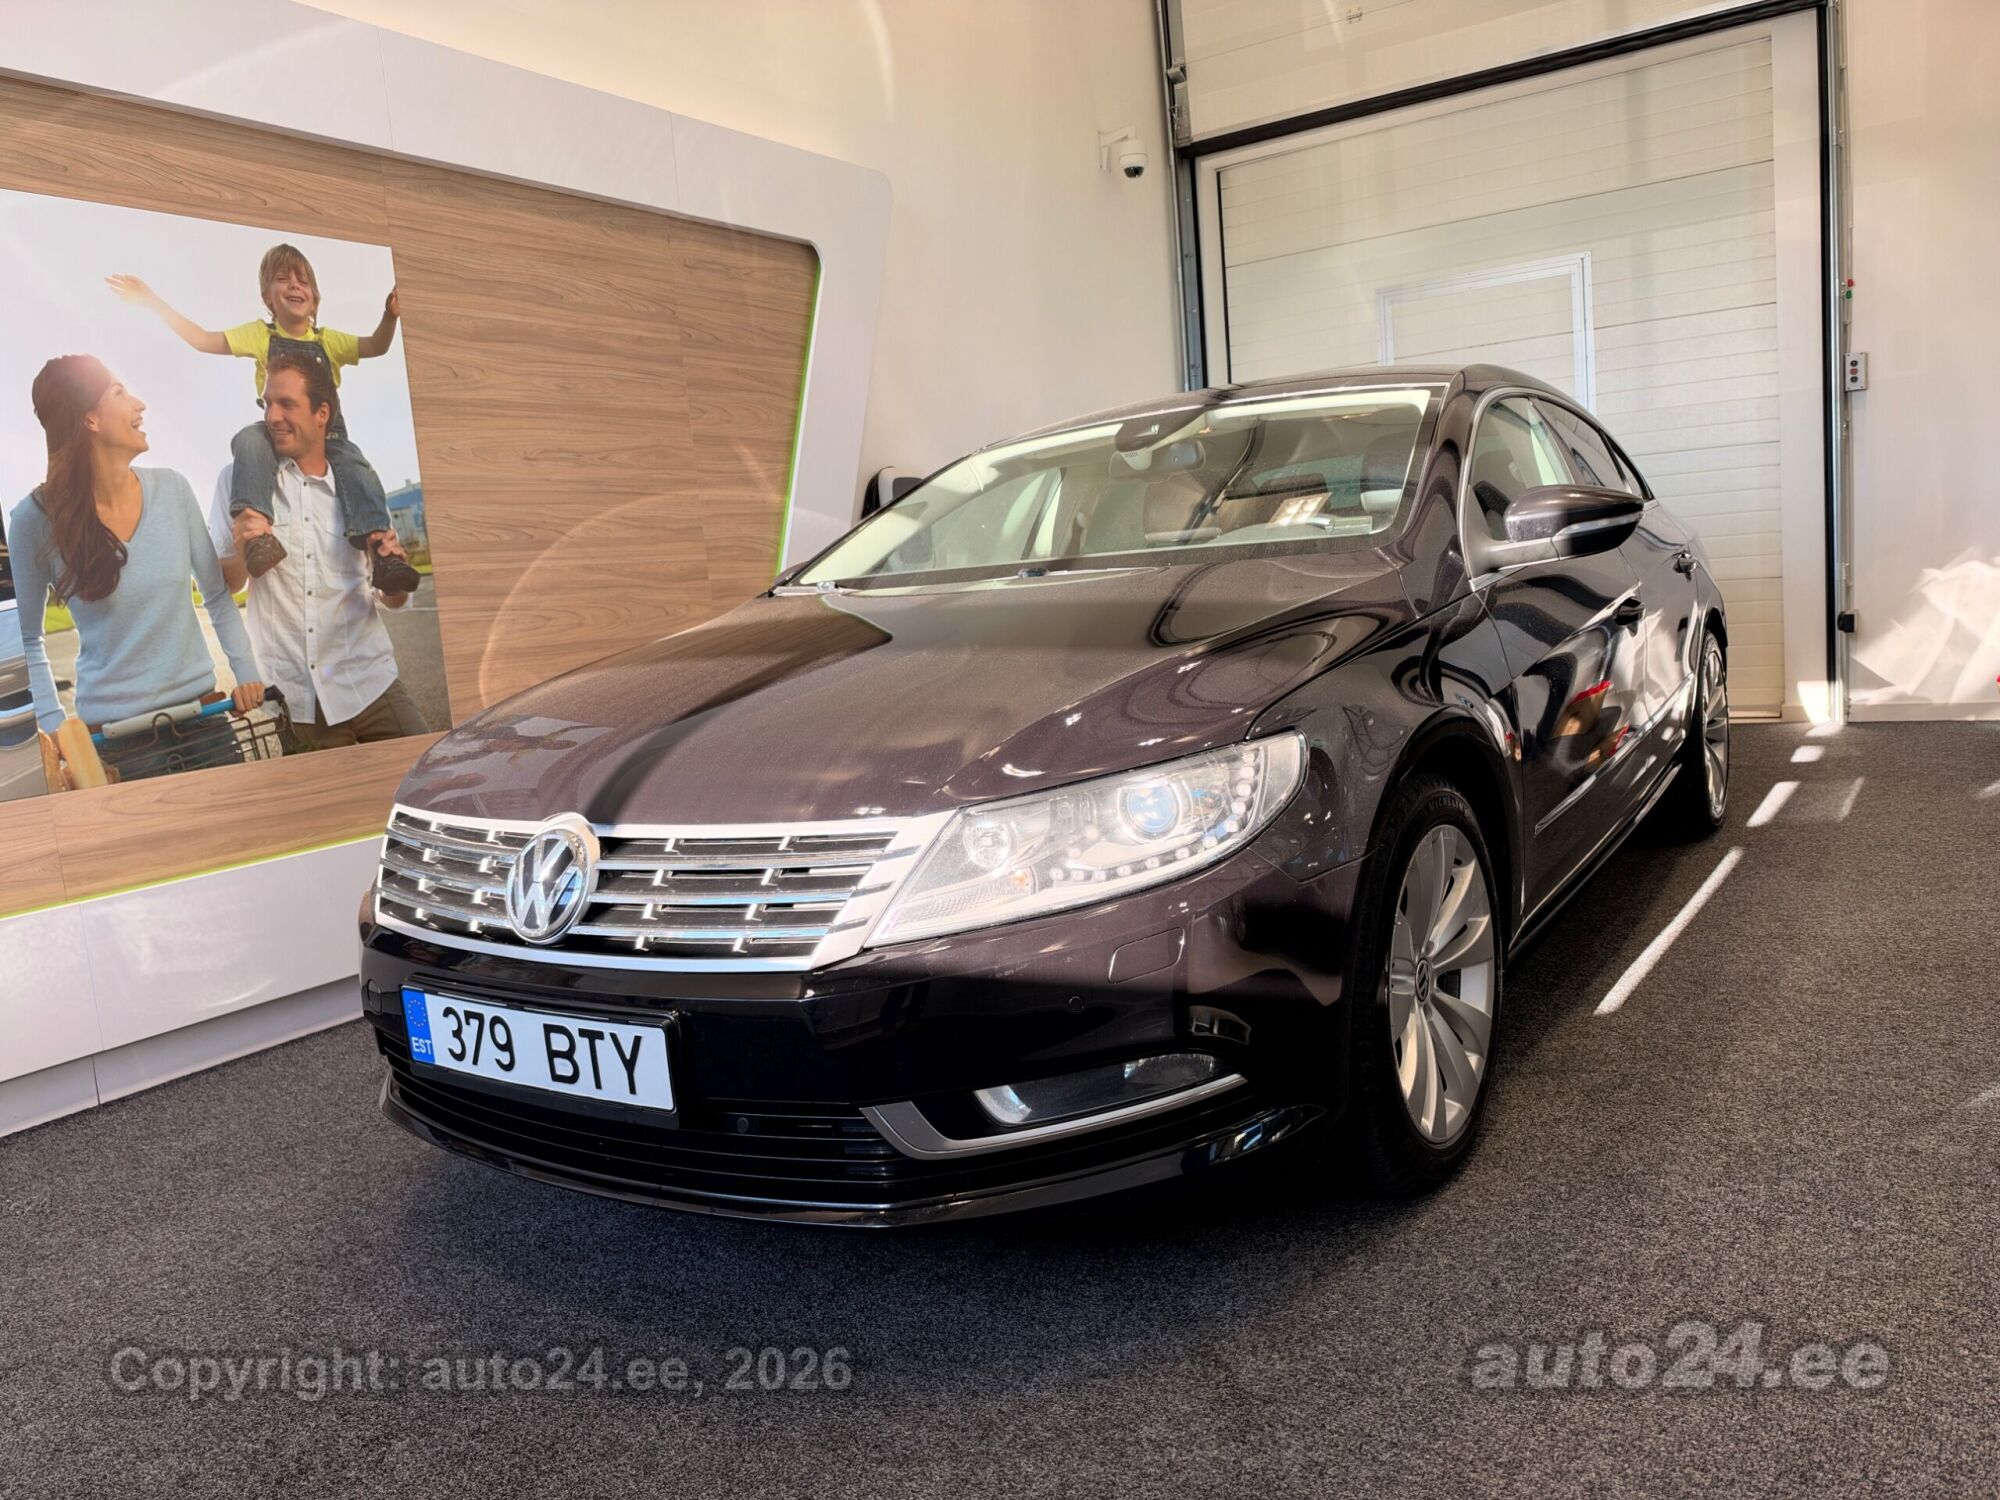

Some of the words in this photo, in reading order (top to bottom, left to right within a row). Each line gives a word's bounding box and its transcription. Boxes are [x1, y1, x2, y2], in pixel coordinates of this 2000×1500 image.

[510, 831, 586, 942] VW
[411, 1036, 432, 1055] EST
[443, 1006, 516, 1072] 379
[543, 1023, 643, 1095] BTY
